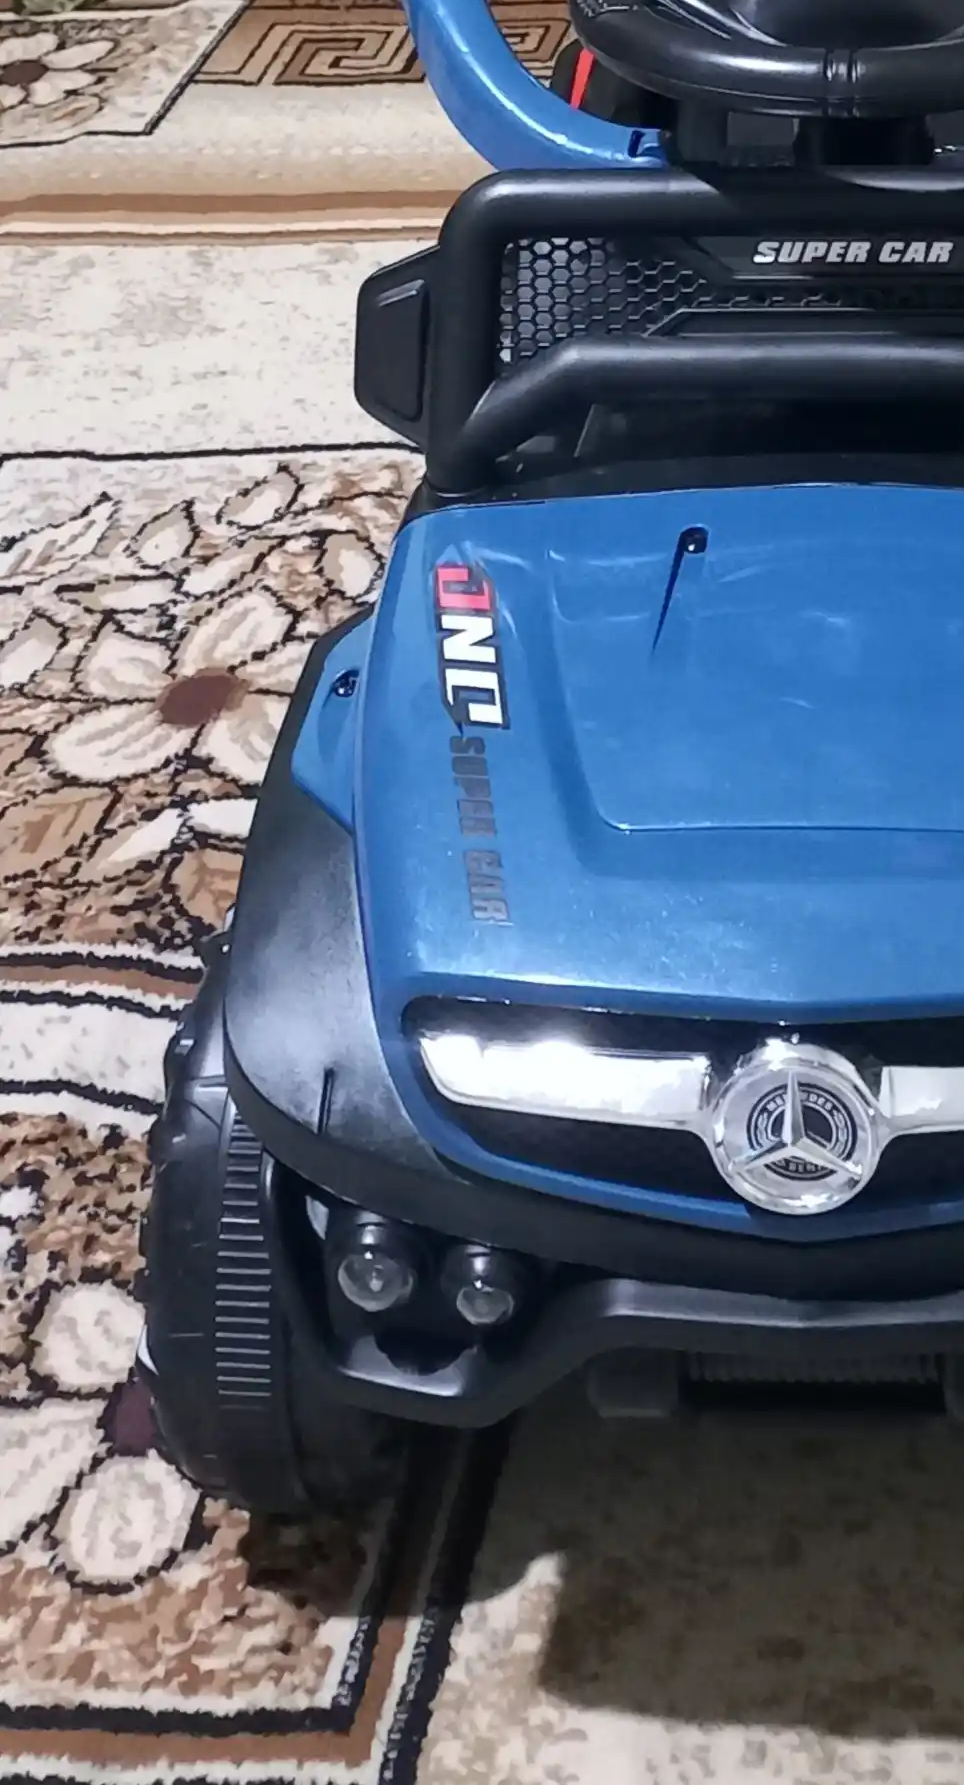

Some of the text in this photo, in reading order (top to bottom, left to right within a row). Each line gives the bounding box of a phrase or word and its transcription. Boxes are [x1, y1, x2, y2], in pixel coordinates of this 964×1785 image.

[753, 241, 954, 264] SUPER CAR
[435, 564, 506, 726] JNC
[449, 736, 511, 922] SUPER CAR
